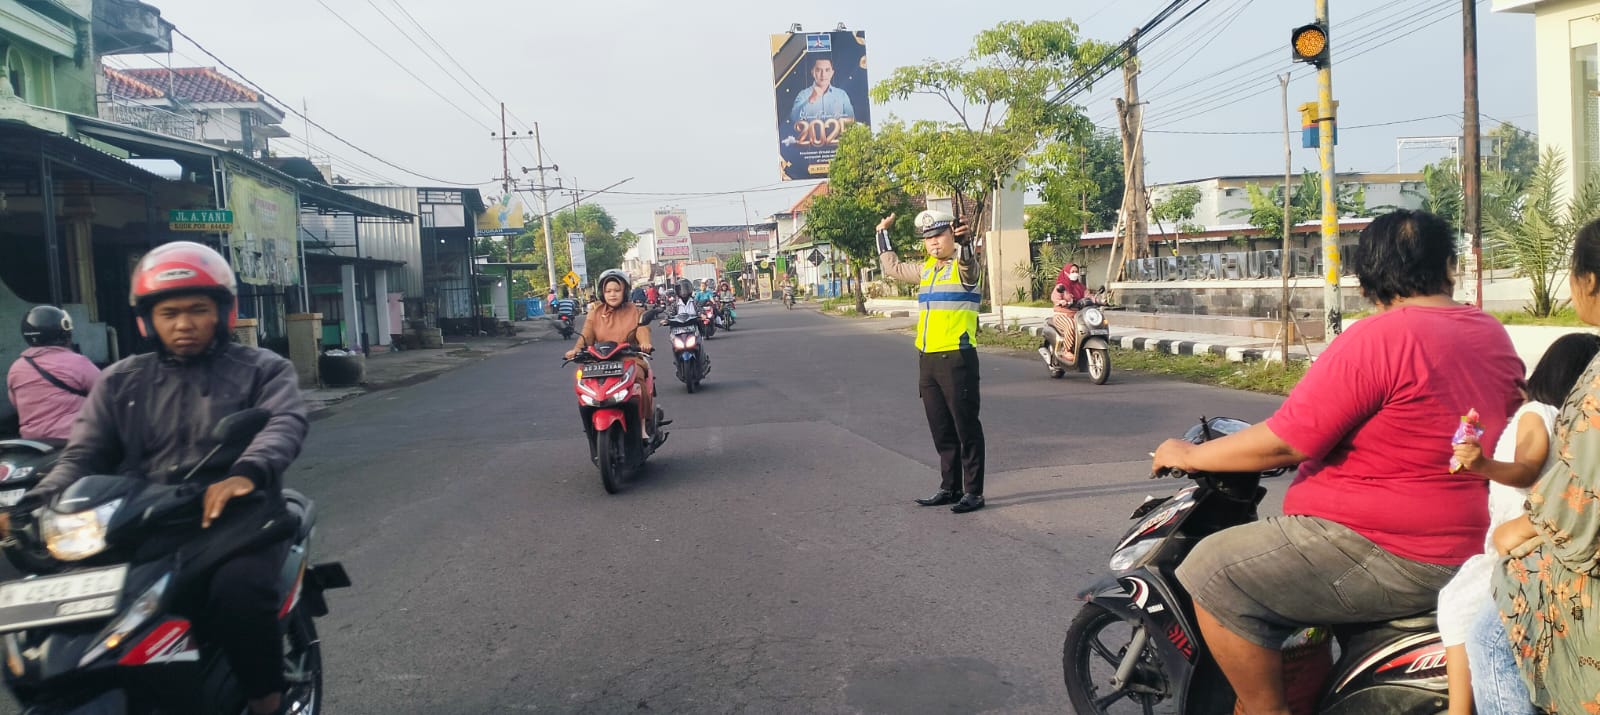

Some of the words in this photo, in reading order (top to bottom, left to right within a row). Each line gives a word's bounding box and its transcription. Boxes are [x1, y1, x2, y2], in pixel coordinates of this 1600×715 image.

[176, 212, 188, 222] JL.
[202, 212, 226, 222] YANI
[1176, 252, 1231, 281] BESAR
